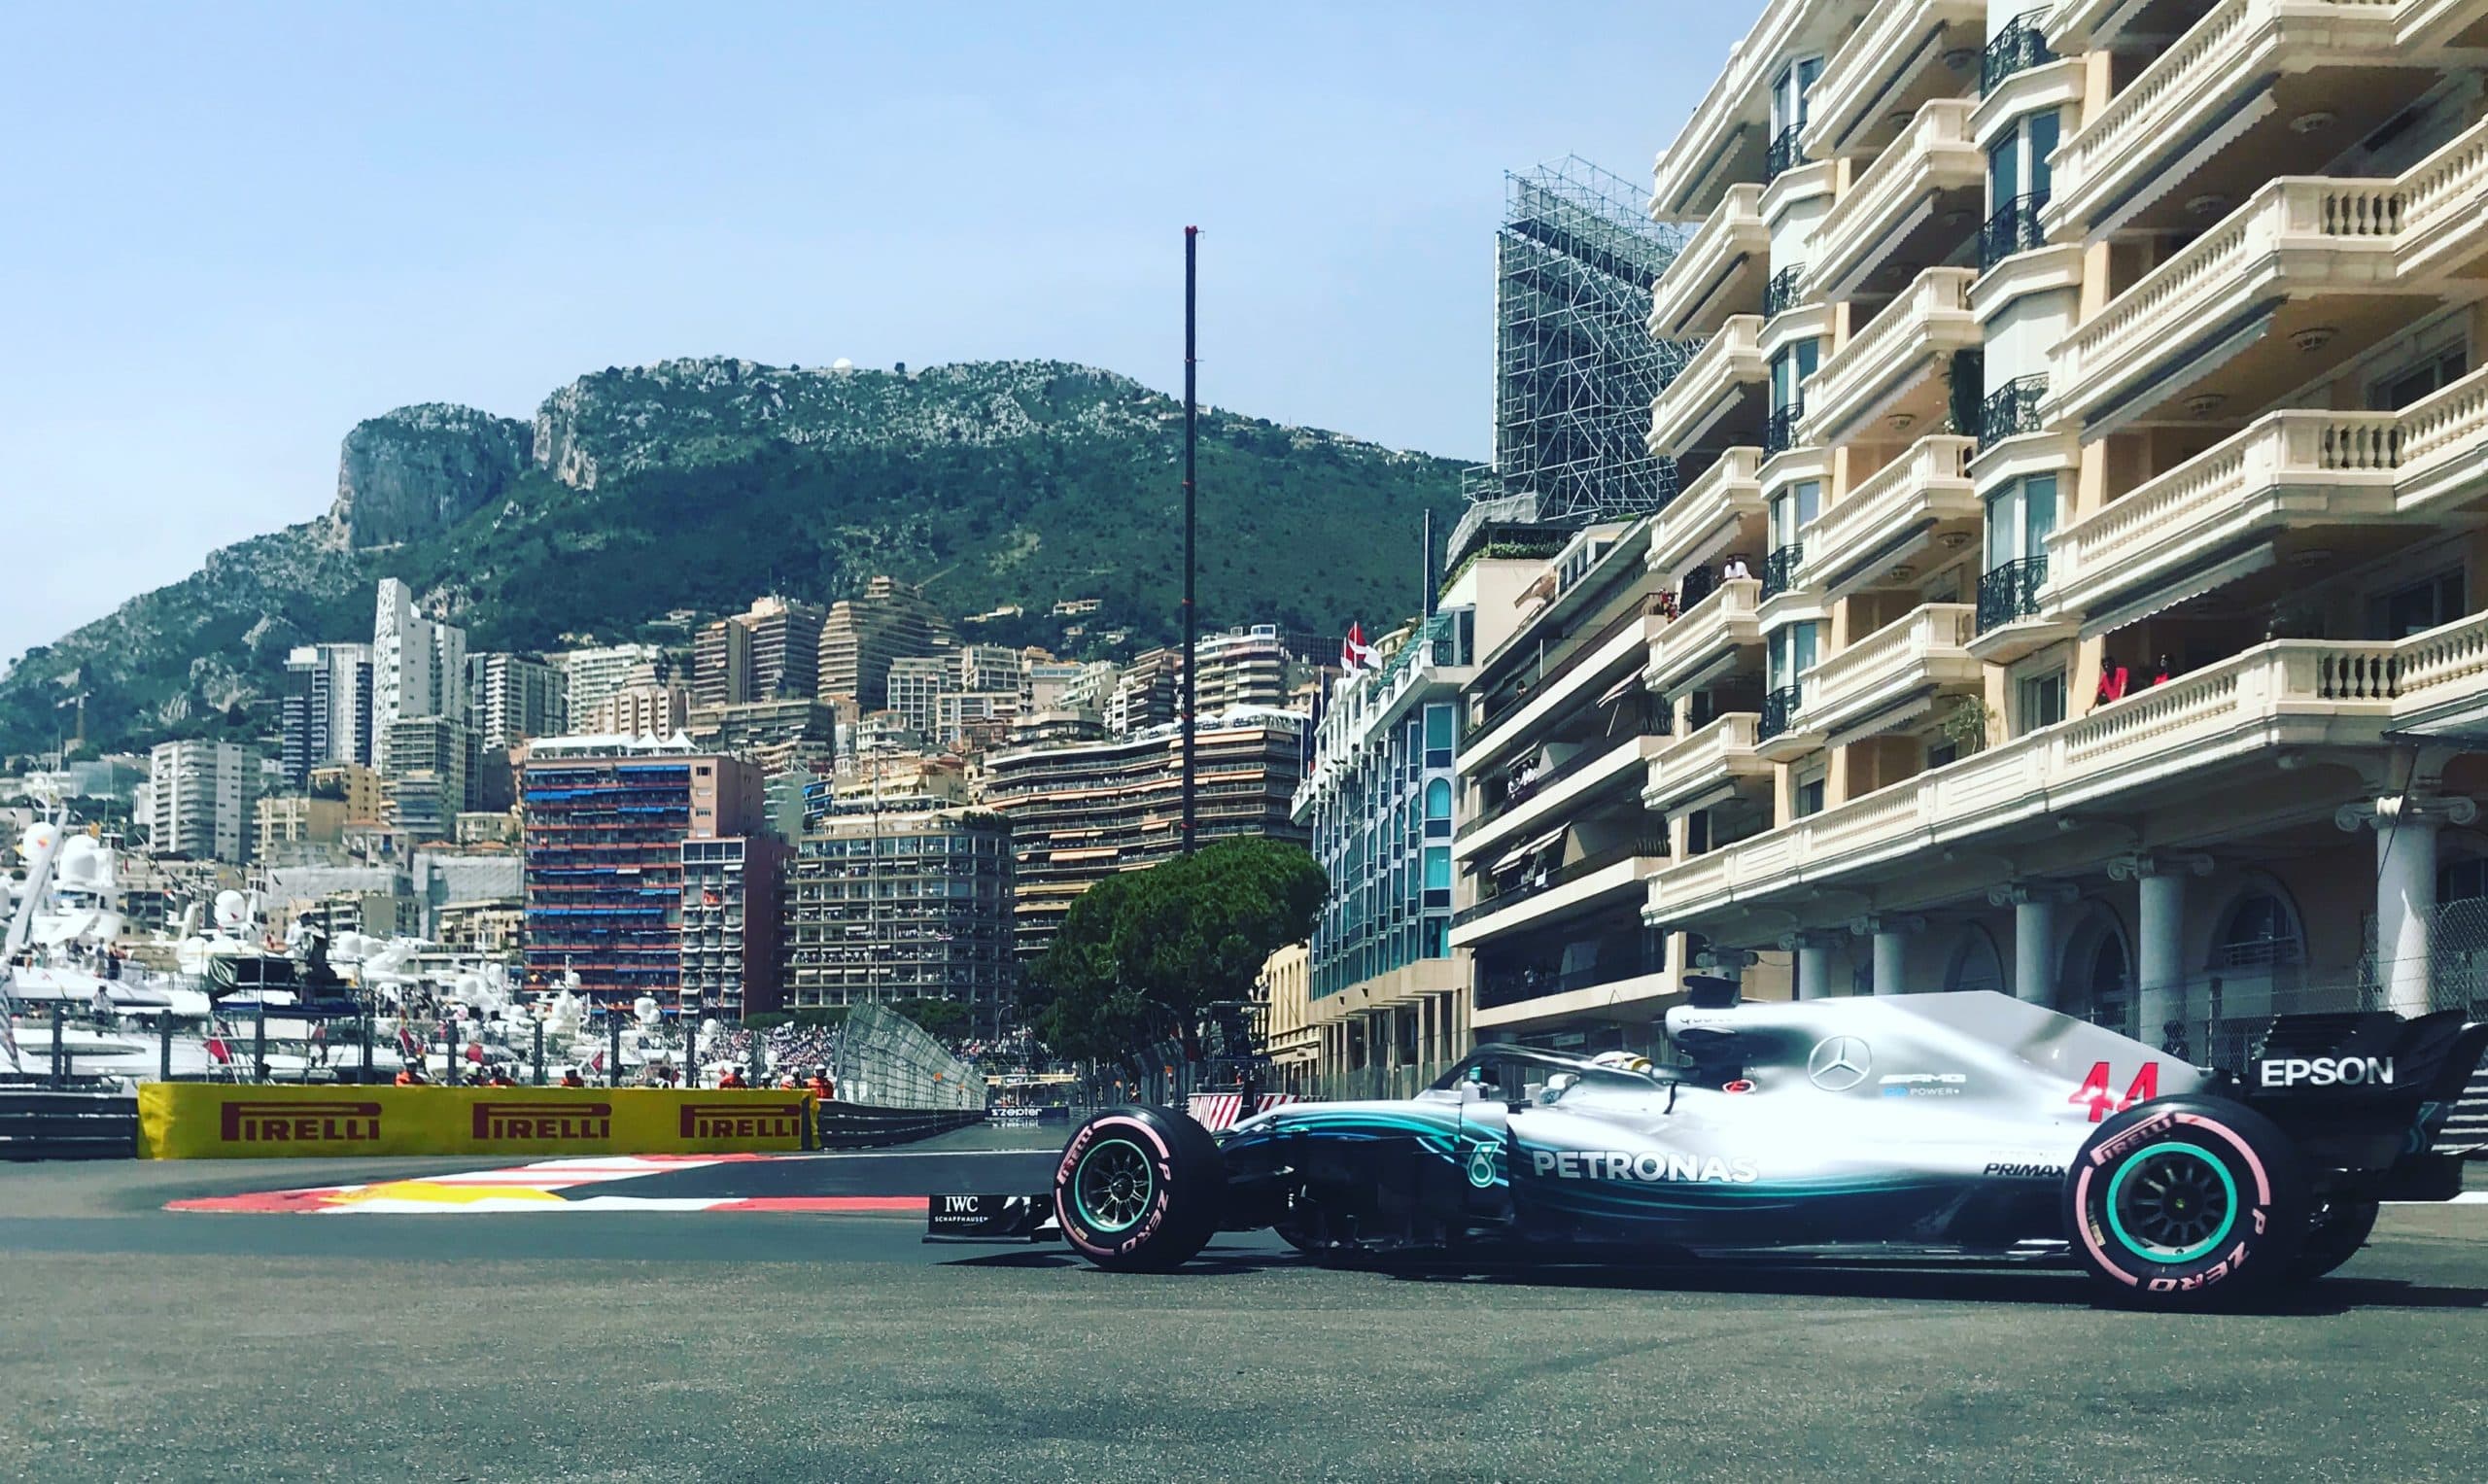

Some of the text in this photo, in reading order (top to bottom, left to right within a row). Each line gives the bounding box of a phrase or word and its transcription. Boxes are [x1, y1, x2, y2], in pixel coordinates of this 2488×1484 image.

[2262, 1056, 2394, 1087] EPSON
[2068, 1061, 2159, 1122] 44
[222, 1102, 382, 1141] PIRELLI
[473, 1103, 611, 1139] PIRELLI
[680, 1104, 801, 1138] PIRELLI
[2090, 1111, 2172, 1166] PIRELLI
[1056, 1125, 1093, 1185] PIRELLI
[1533, 1151, 1758, 1183] PETRONAS
[1984, 1162, 2066, 1177] PRIMAX
[945, 1196, 979, 1212] IWC
[1122, 1162, 1171, 1254] P ZERO
[2148, 1208, 2266, 1291] P ZERO
